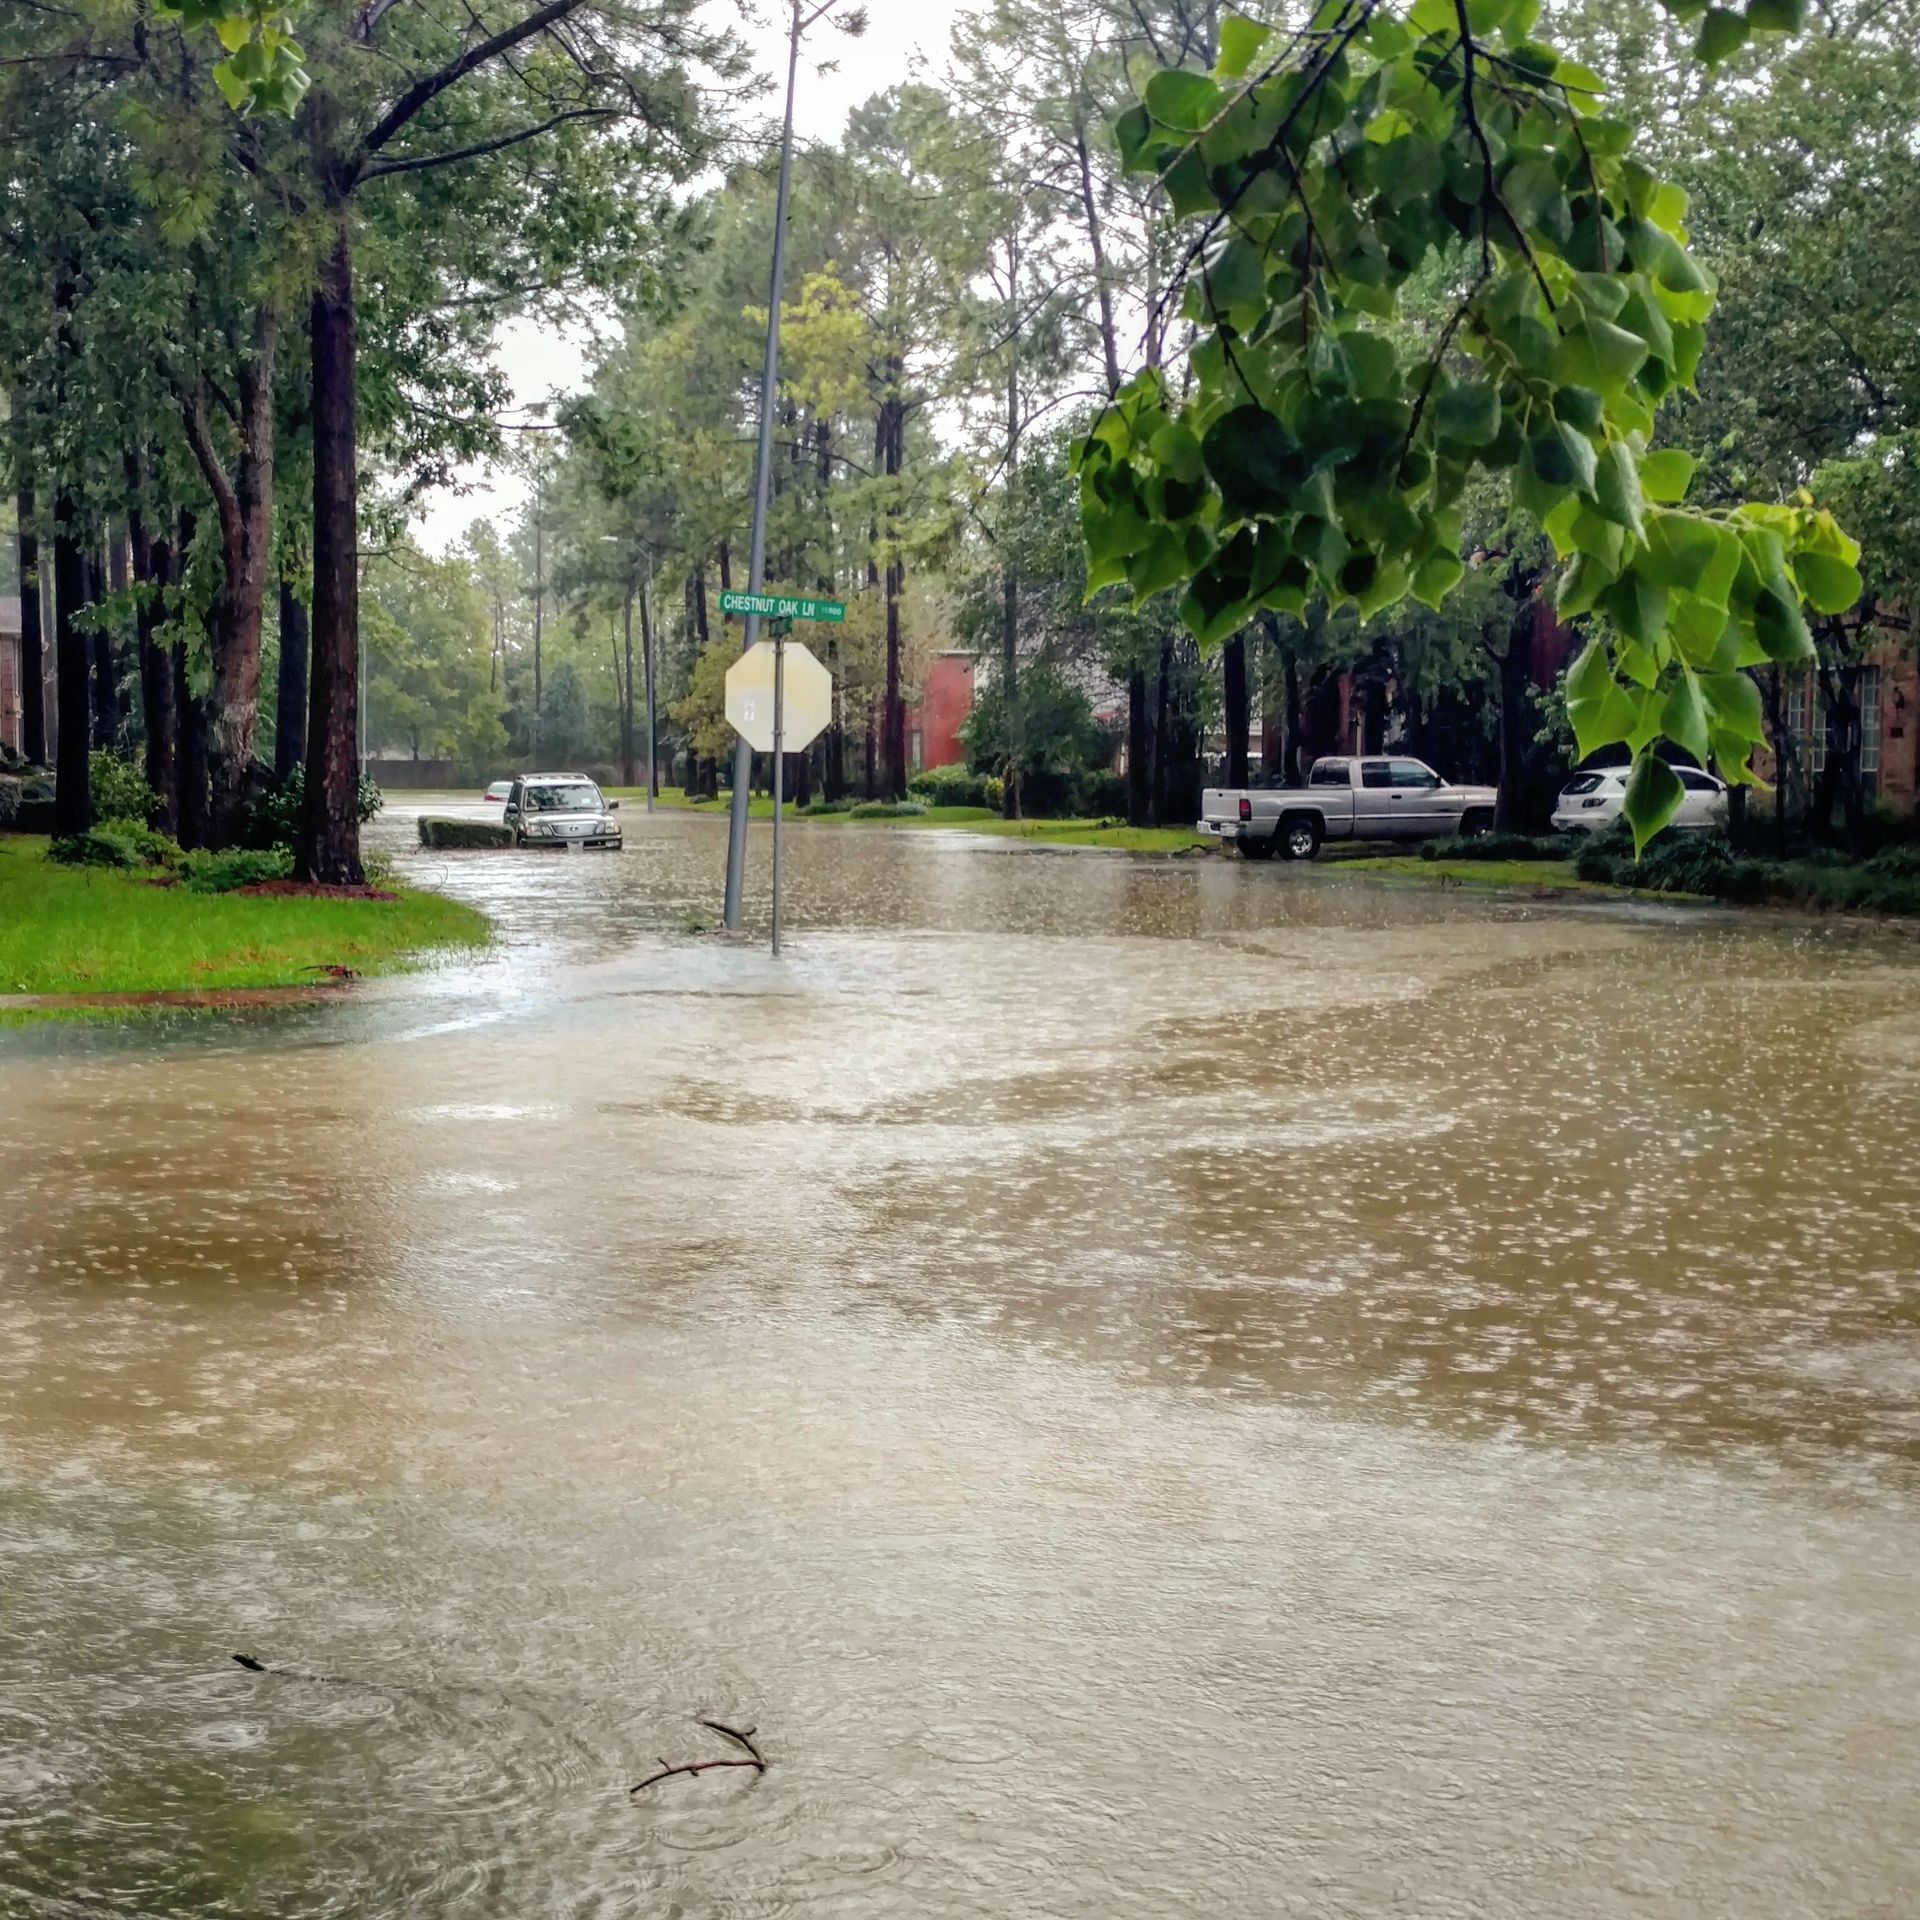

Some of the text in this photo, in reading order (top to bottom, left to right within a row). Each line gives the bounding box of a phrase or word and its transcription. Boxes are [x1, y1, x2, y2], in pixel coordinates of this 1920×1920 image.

[723, 594, 776, 613] CHESTNUT
[778, 599, 798, 615] OAK
[802, 602, 816, 616] LN
